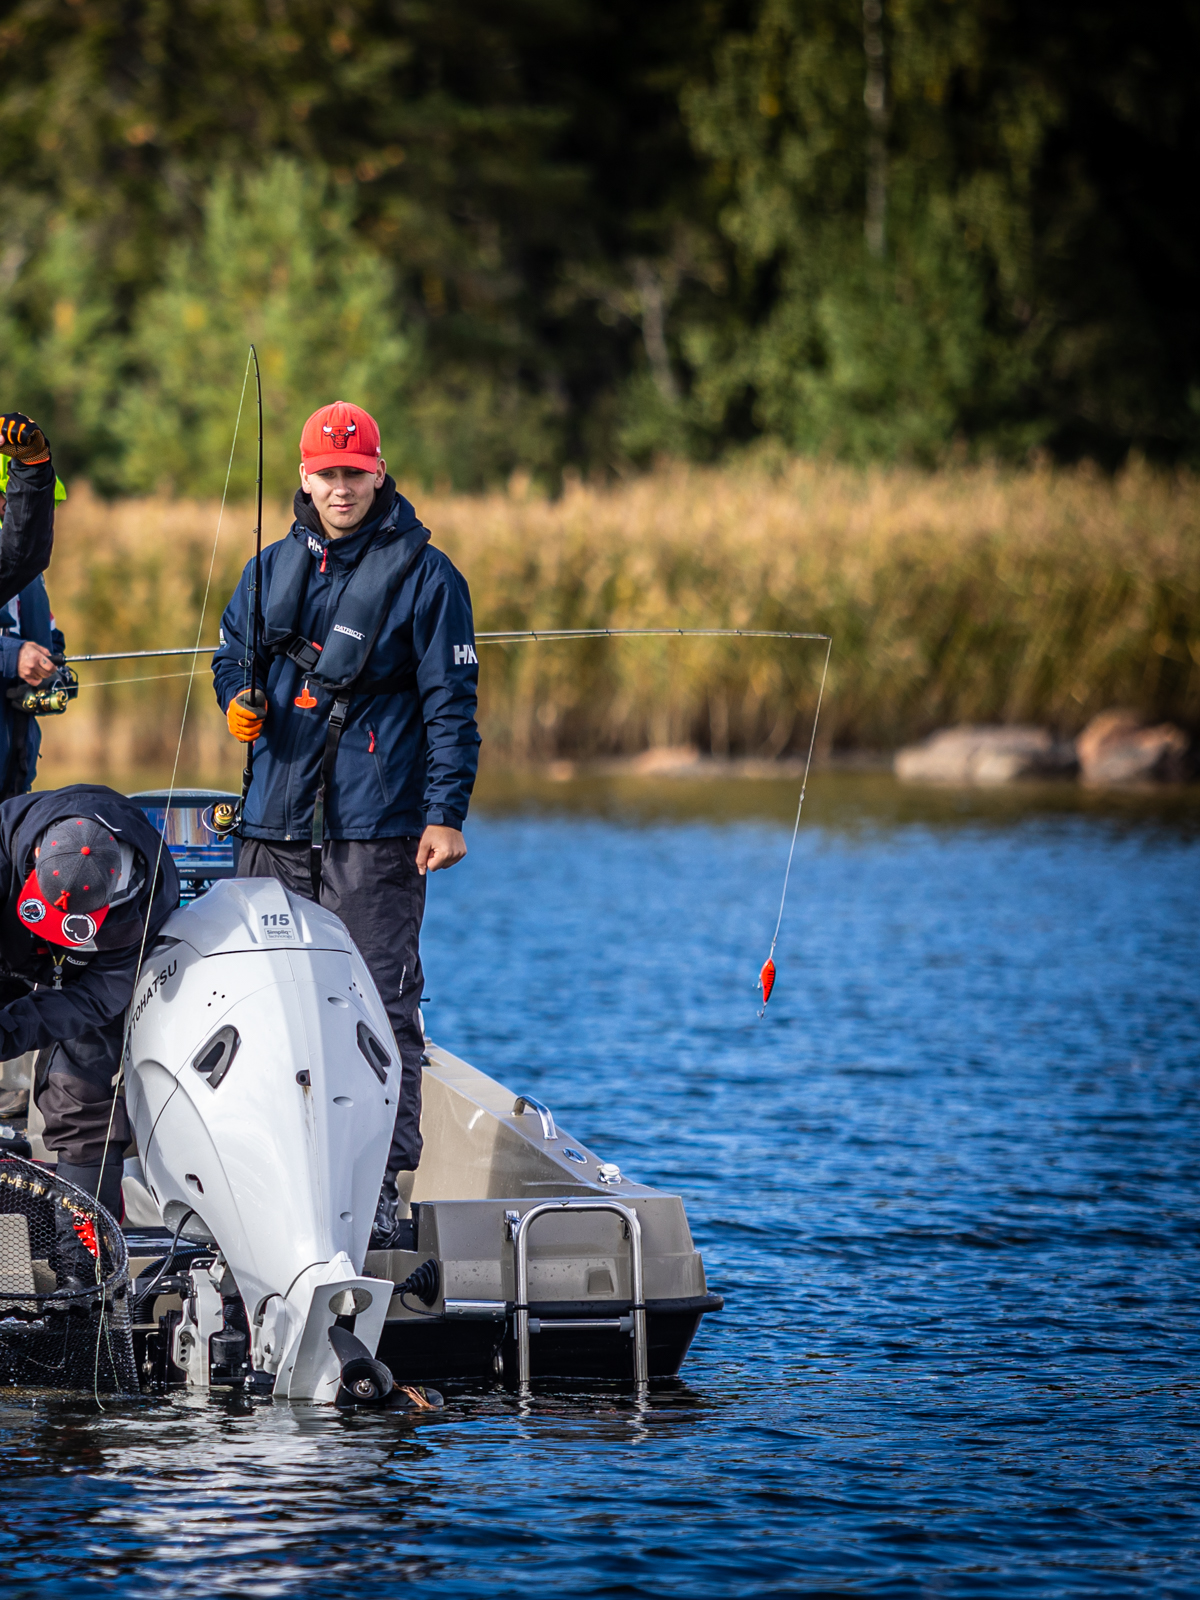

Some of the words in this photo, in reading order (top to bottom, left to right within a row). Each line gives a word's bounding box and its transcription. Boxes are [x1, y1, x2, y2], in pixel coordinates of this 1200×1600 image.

[333, 624, 363, 640] PATRIOT
[453, 644, 478, 665] HH
[261, 914, 290, 926] 115
[132, 959, 177, 1030] TOHATSU
[7, 1177, 46, 1195] WESTIN
